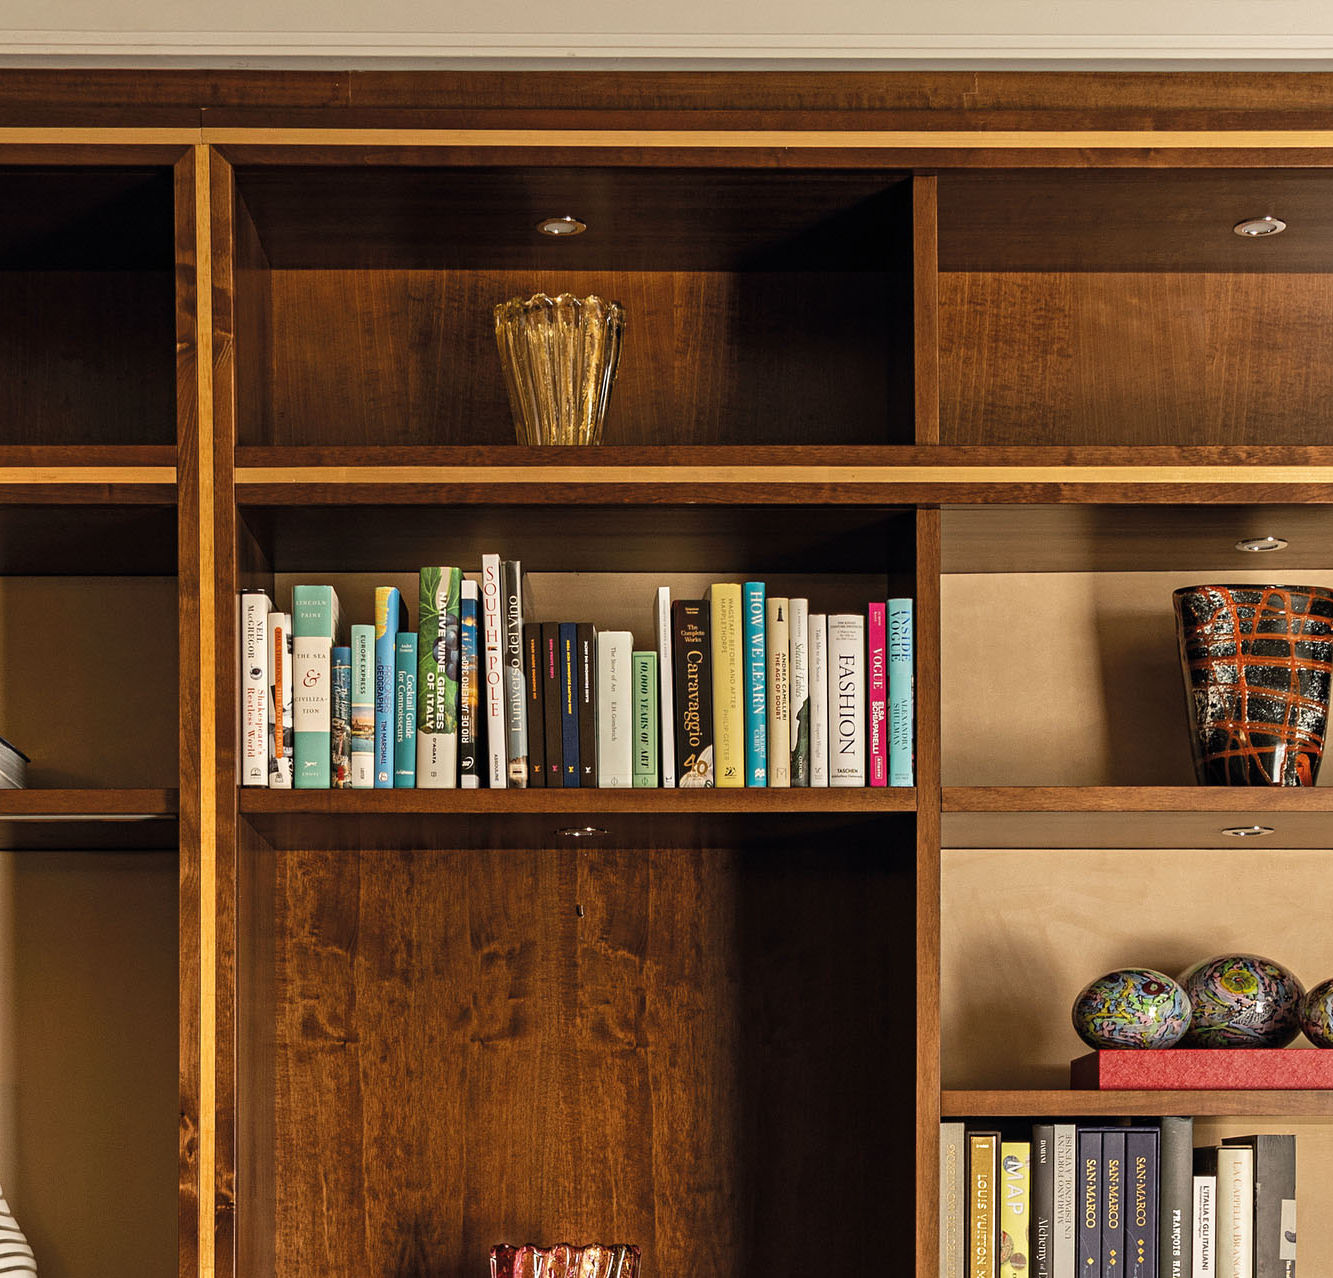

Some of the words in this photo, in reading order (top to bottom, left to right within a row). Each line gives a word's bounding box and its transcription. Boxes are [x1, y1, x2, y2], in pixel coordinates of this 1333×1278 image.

[438, 592, 447, 636] NATIVE
[484, 566, 498, 642] SOUTH
[750, 592, 762, 633] HOW
[438, 640, 446, 670] WINE
[751, 634, 763, 653] WE
[427, 673, 435, 688] OF
[436, 673, 445, 728] GRAPES
[487, 656, 500, 717] POLE
[683, 650, 704, 747] Caravaggio
[752, 655, 764, 714] LEARN
[838, 654, 855, 755] FASHION
[426, 691, 435, 728] ITALY
[1007, 1161, 1023, 1215] MAP
